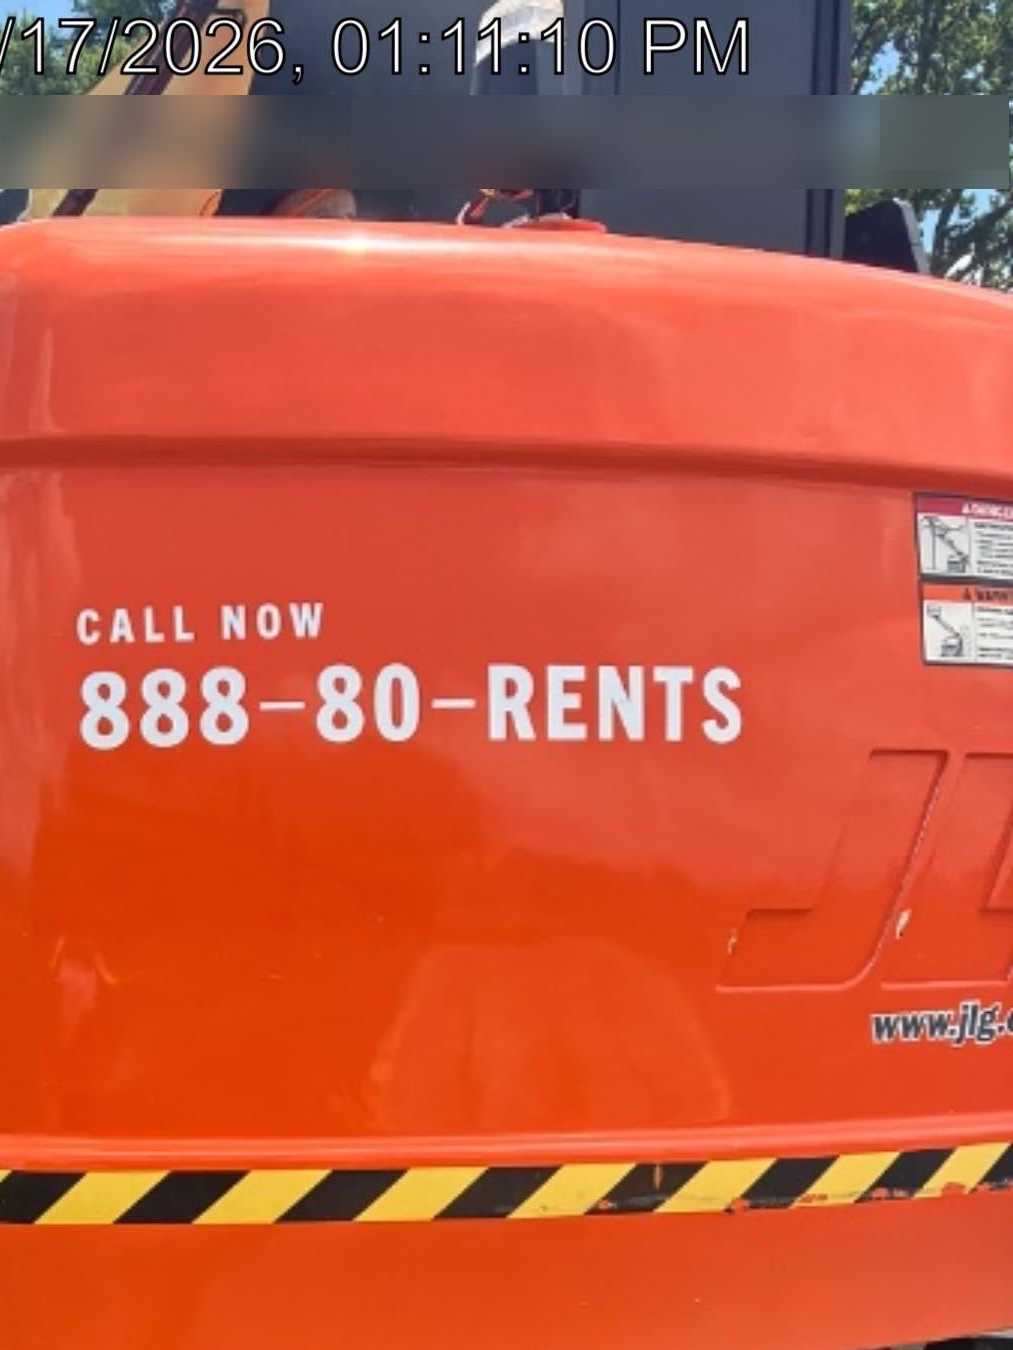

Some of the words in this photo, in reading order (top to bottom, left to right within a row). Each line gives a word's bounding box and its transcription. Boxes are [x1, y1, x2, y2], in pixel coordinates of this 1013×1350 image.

[76, 605, 196, 646] CALL
[220, 602, 325, 642] NOW
[79, 662, 744, 750] 888-80-RENTS
